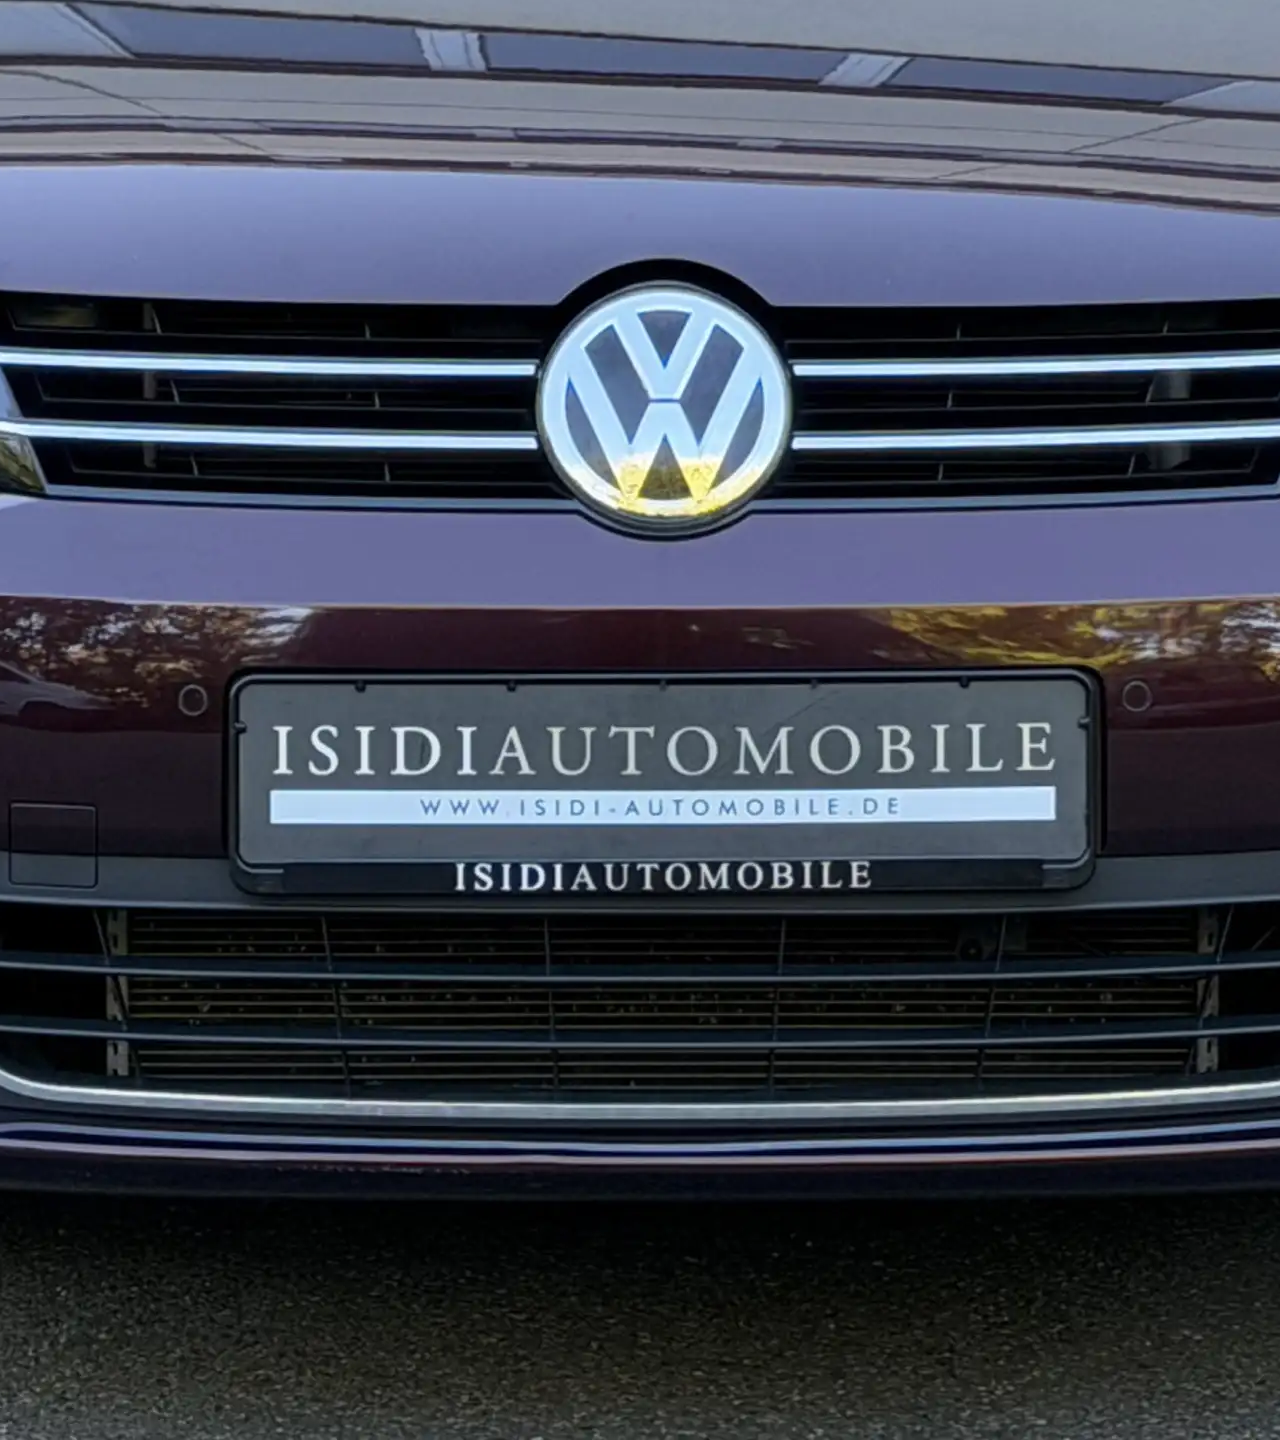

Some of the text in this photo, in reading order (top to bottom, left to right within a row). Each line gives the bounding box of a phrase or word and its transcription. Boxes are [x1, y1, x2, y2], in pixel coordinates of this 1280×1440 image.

[556, 295, 774, 510] VW
[271, 722, 1057, 777] ISIDIAUTOMOBILE
[419, 796, 901, 817] WWW.ISIDI-AUTOMOBILE.DE
[454, 860, 873, 892] ISIDIAUTOMOBILE
